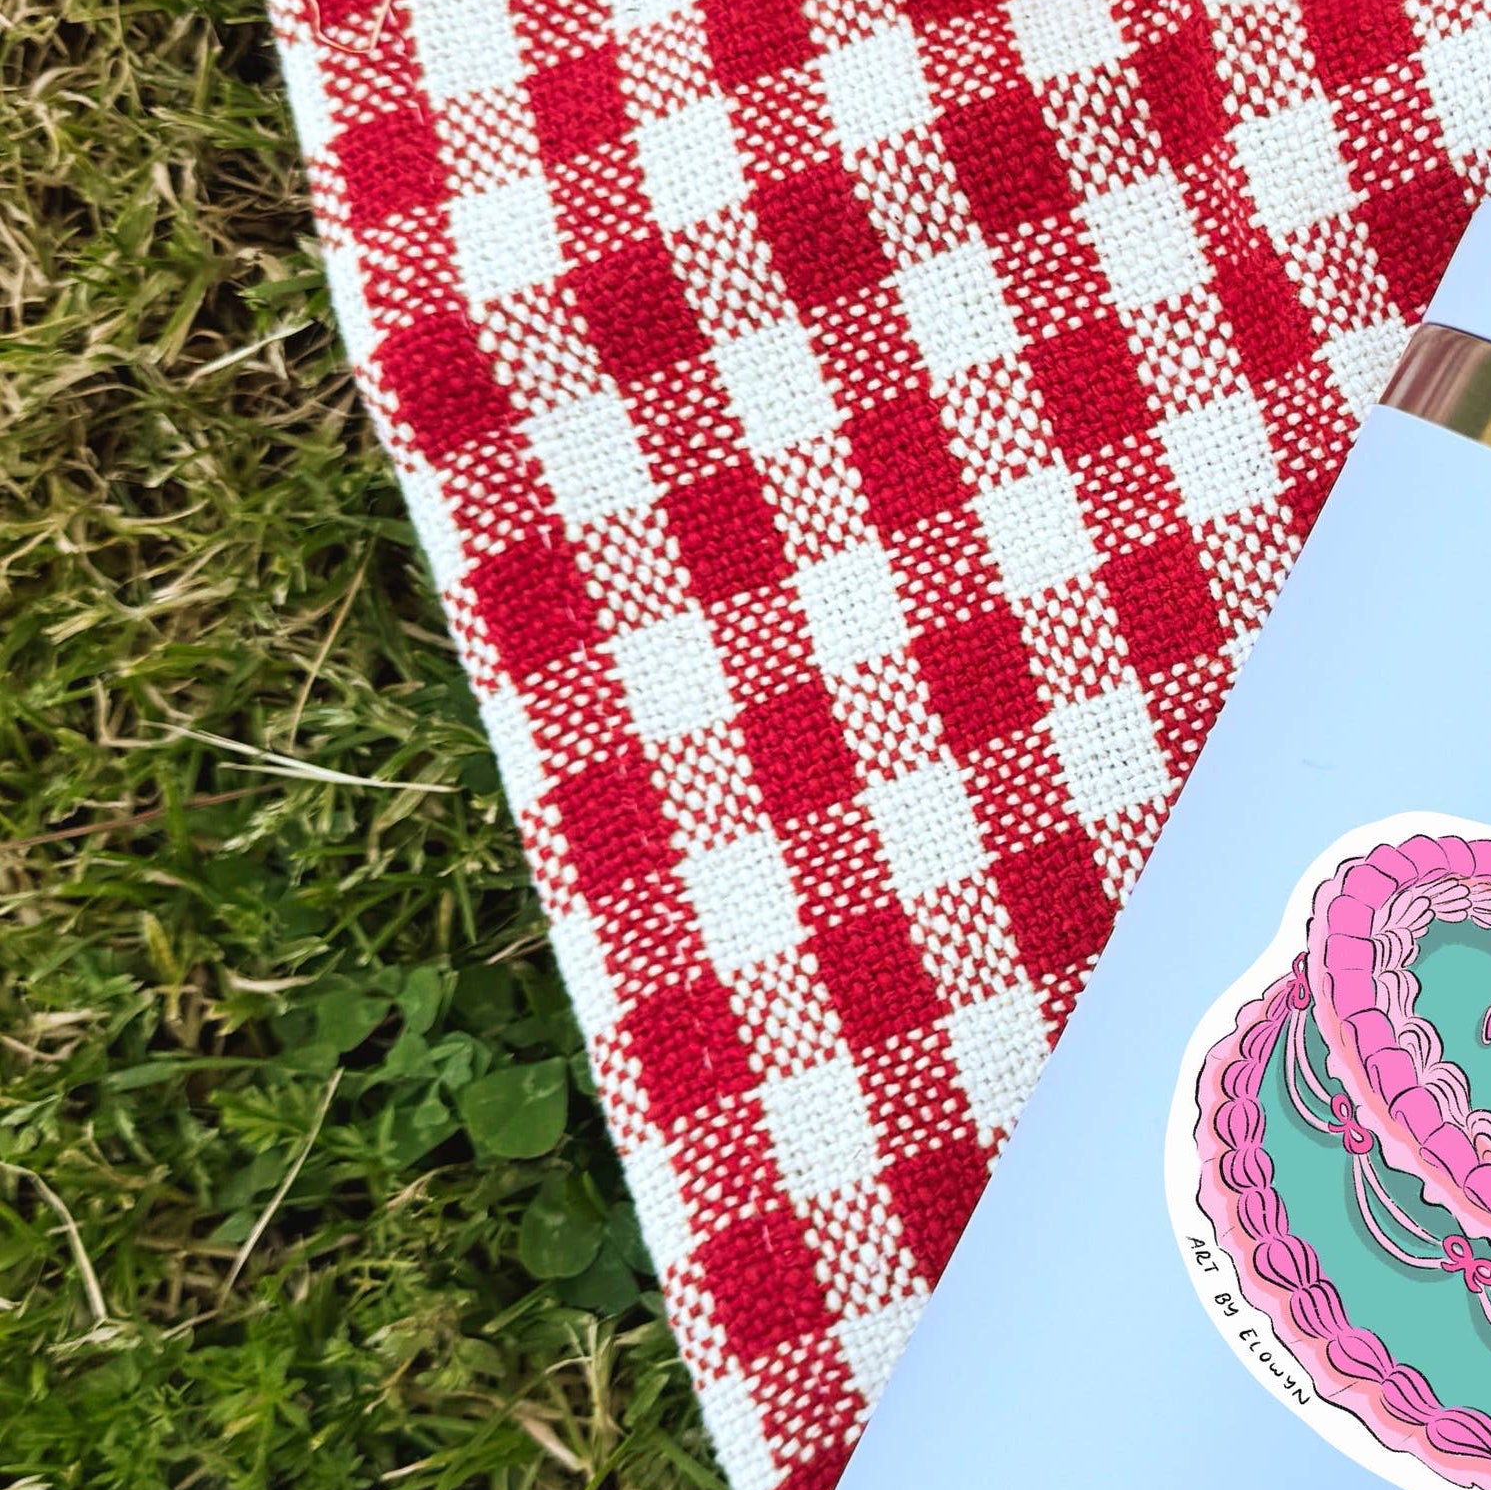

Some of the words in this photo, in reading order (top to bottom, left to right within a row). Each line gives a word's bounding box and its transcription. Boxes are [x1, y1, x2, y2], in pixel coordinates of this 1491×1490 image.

[1186, 1236, 1220, 1272] ART
[1214, 1292, 1239, 1317] BY
[1238, 1328, 1311, 1405] ELOWYN
